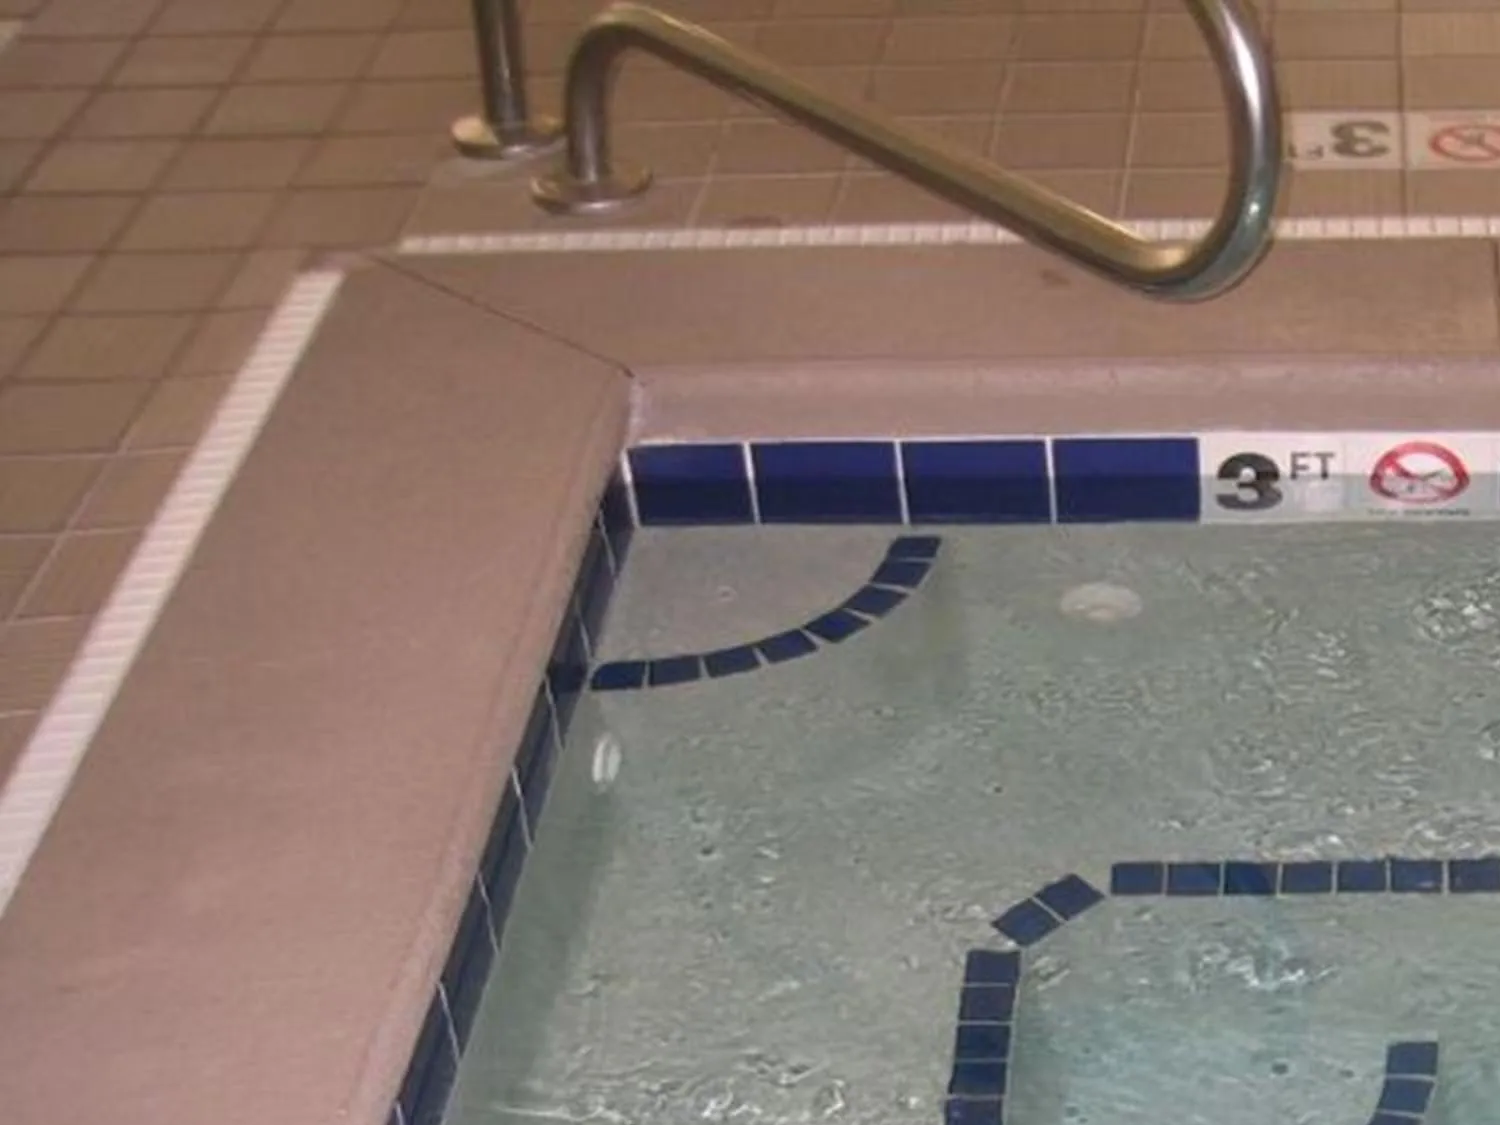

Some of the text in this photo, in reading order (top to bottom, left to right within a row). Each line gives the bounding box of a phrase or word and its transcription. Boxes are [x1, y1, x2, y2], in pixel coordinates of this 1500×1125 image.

[1330, 119, 1391, 158] 3
[1215, 451, 1335, 511] 3 FT
